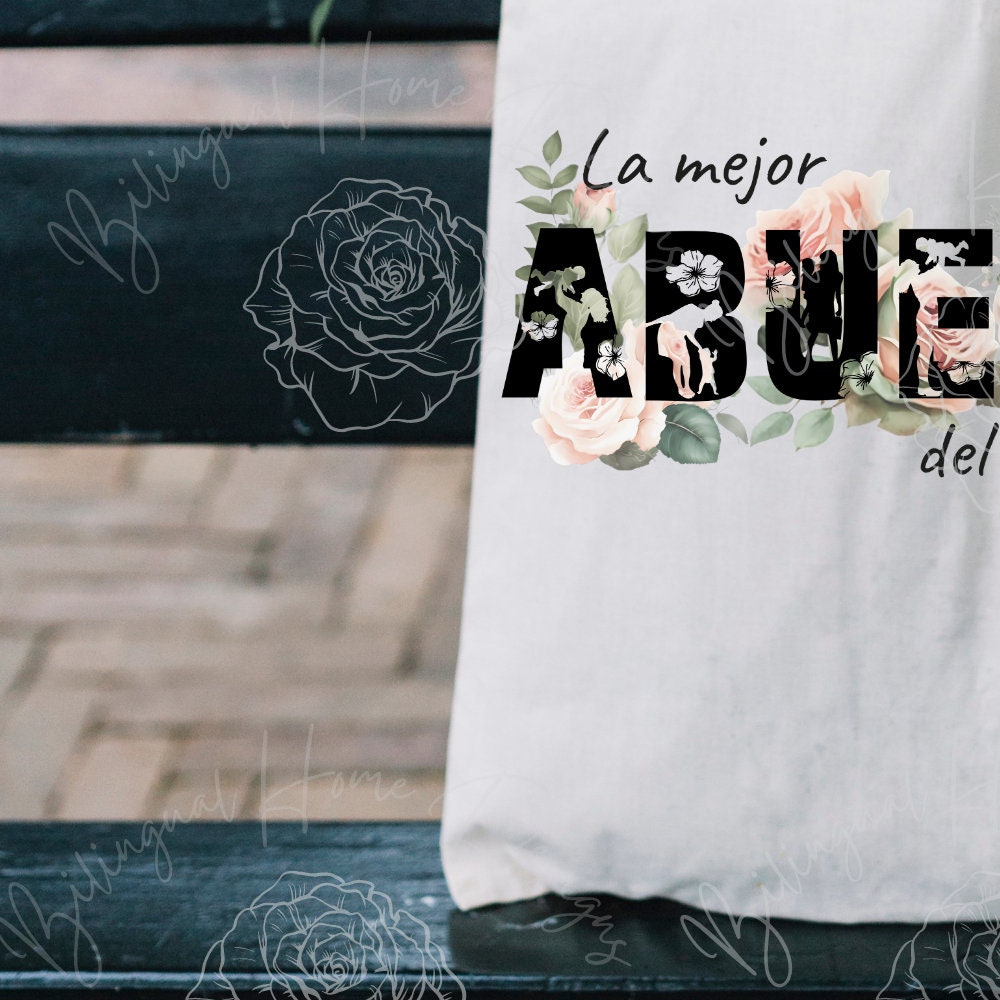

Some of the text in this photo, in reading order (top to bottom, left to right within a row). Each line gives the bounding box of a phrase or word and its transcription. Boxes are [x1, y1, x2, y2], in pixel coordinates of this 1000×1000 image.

[582, 128, 827, 205] La mejor
[919, 423, 999, 476] del
